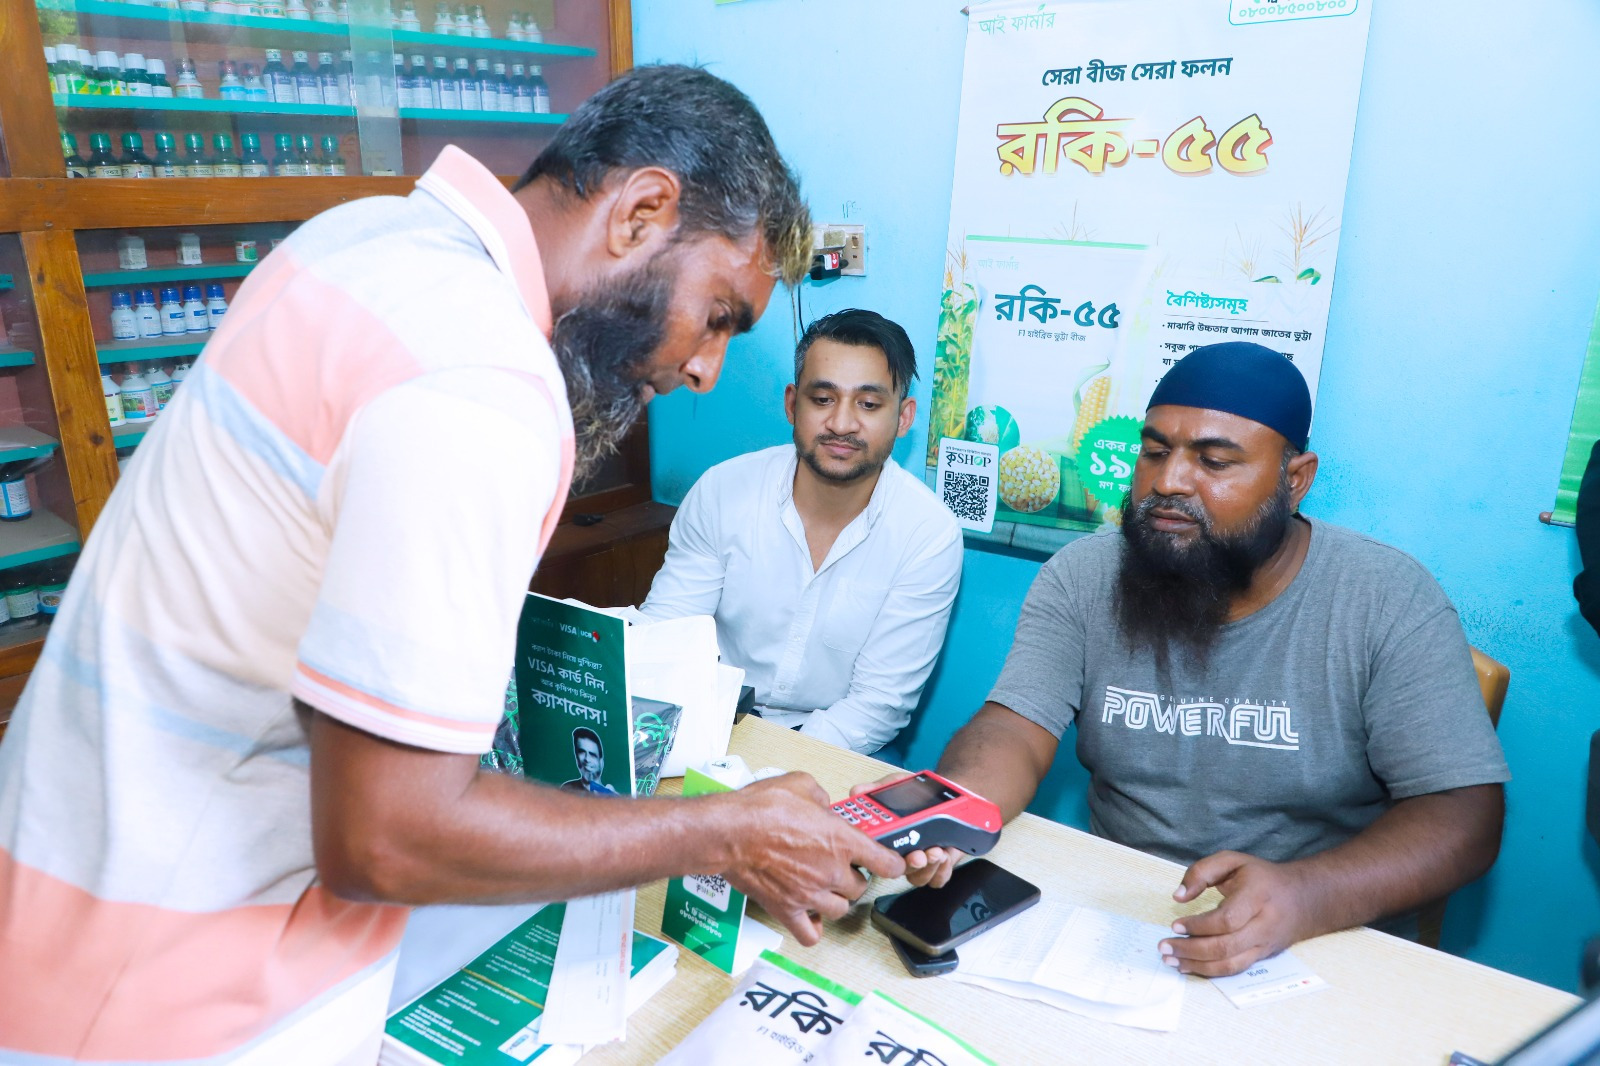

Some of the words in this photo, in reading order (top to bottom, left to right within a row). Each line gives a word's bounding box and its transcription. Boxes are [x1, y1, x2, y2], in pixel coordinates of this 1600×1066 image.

[978, 14, 1007, 35] আই
[1011, 4, 1056, 32] ফার্মার
[1239, 0, 1347, 18] ০৮০০৮৫০০৮০০
[1042, 66, 1082, 86] সেরা
[1086, 58, 1127, 83] বীজ
[1131, 59, 1177, 81] সেরা
[1181, 57, 1234, 78] ফলন
[996, 96, 1274, 178] রকি-৫৫
[994, 284, 1121, 329] রকি-৫৫
[1166, 290, 1249, 315] বৈশিষ্ট্যসমূহ
[1027, 330, 1053, 340] হাইব্রিড
[1070, 332, 1086, 342] বীজ
[1167, 322, 1195, 331] মাঝারি
[1197, 322, 1228, 334] উচ্চতার
[1230, 326, 1259, 336] আগাম
[1261, 329, 1291, 339] জাতের
[1293, 330, 1312, 342] ভুট্টা
[1164, 343, 1186, 353] সবুজ
[1162, 358, 1171, 366] যা
[1094, 439, 1128, 453] একর
[1130, 443, 1142, 455] প্র
[1090, 451, 1136, 479] ১৯
[1099, 480, 1114, 491] মণ
[559, 622, 577, 635] VISA
[580, 630, 592, 639] UCB
[527, 656, 556, 676] VISA
[557, 667, 582, 684] কার্ড
[584, 671, 608, 694] নিন,
[531, 688, 608, 727] ক্যাশলেস!
[1159, 694, 1214, 705] GEUINE
[1224, 697, 1288, 707] QUALITY
[1101, 685, 1300, 751] POWERFUL
[893, 834, 910, 848] UCB
[739, 981, 845, 1036] রকি
